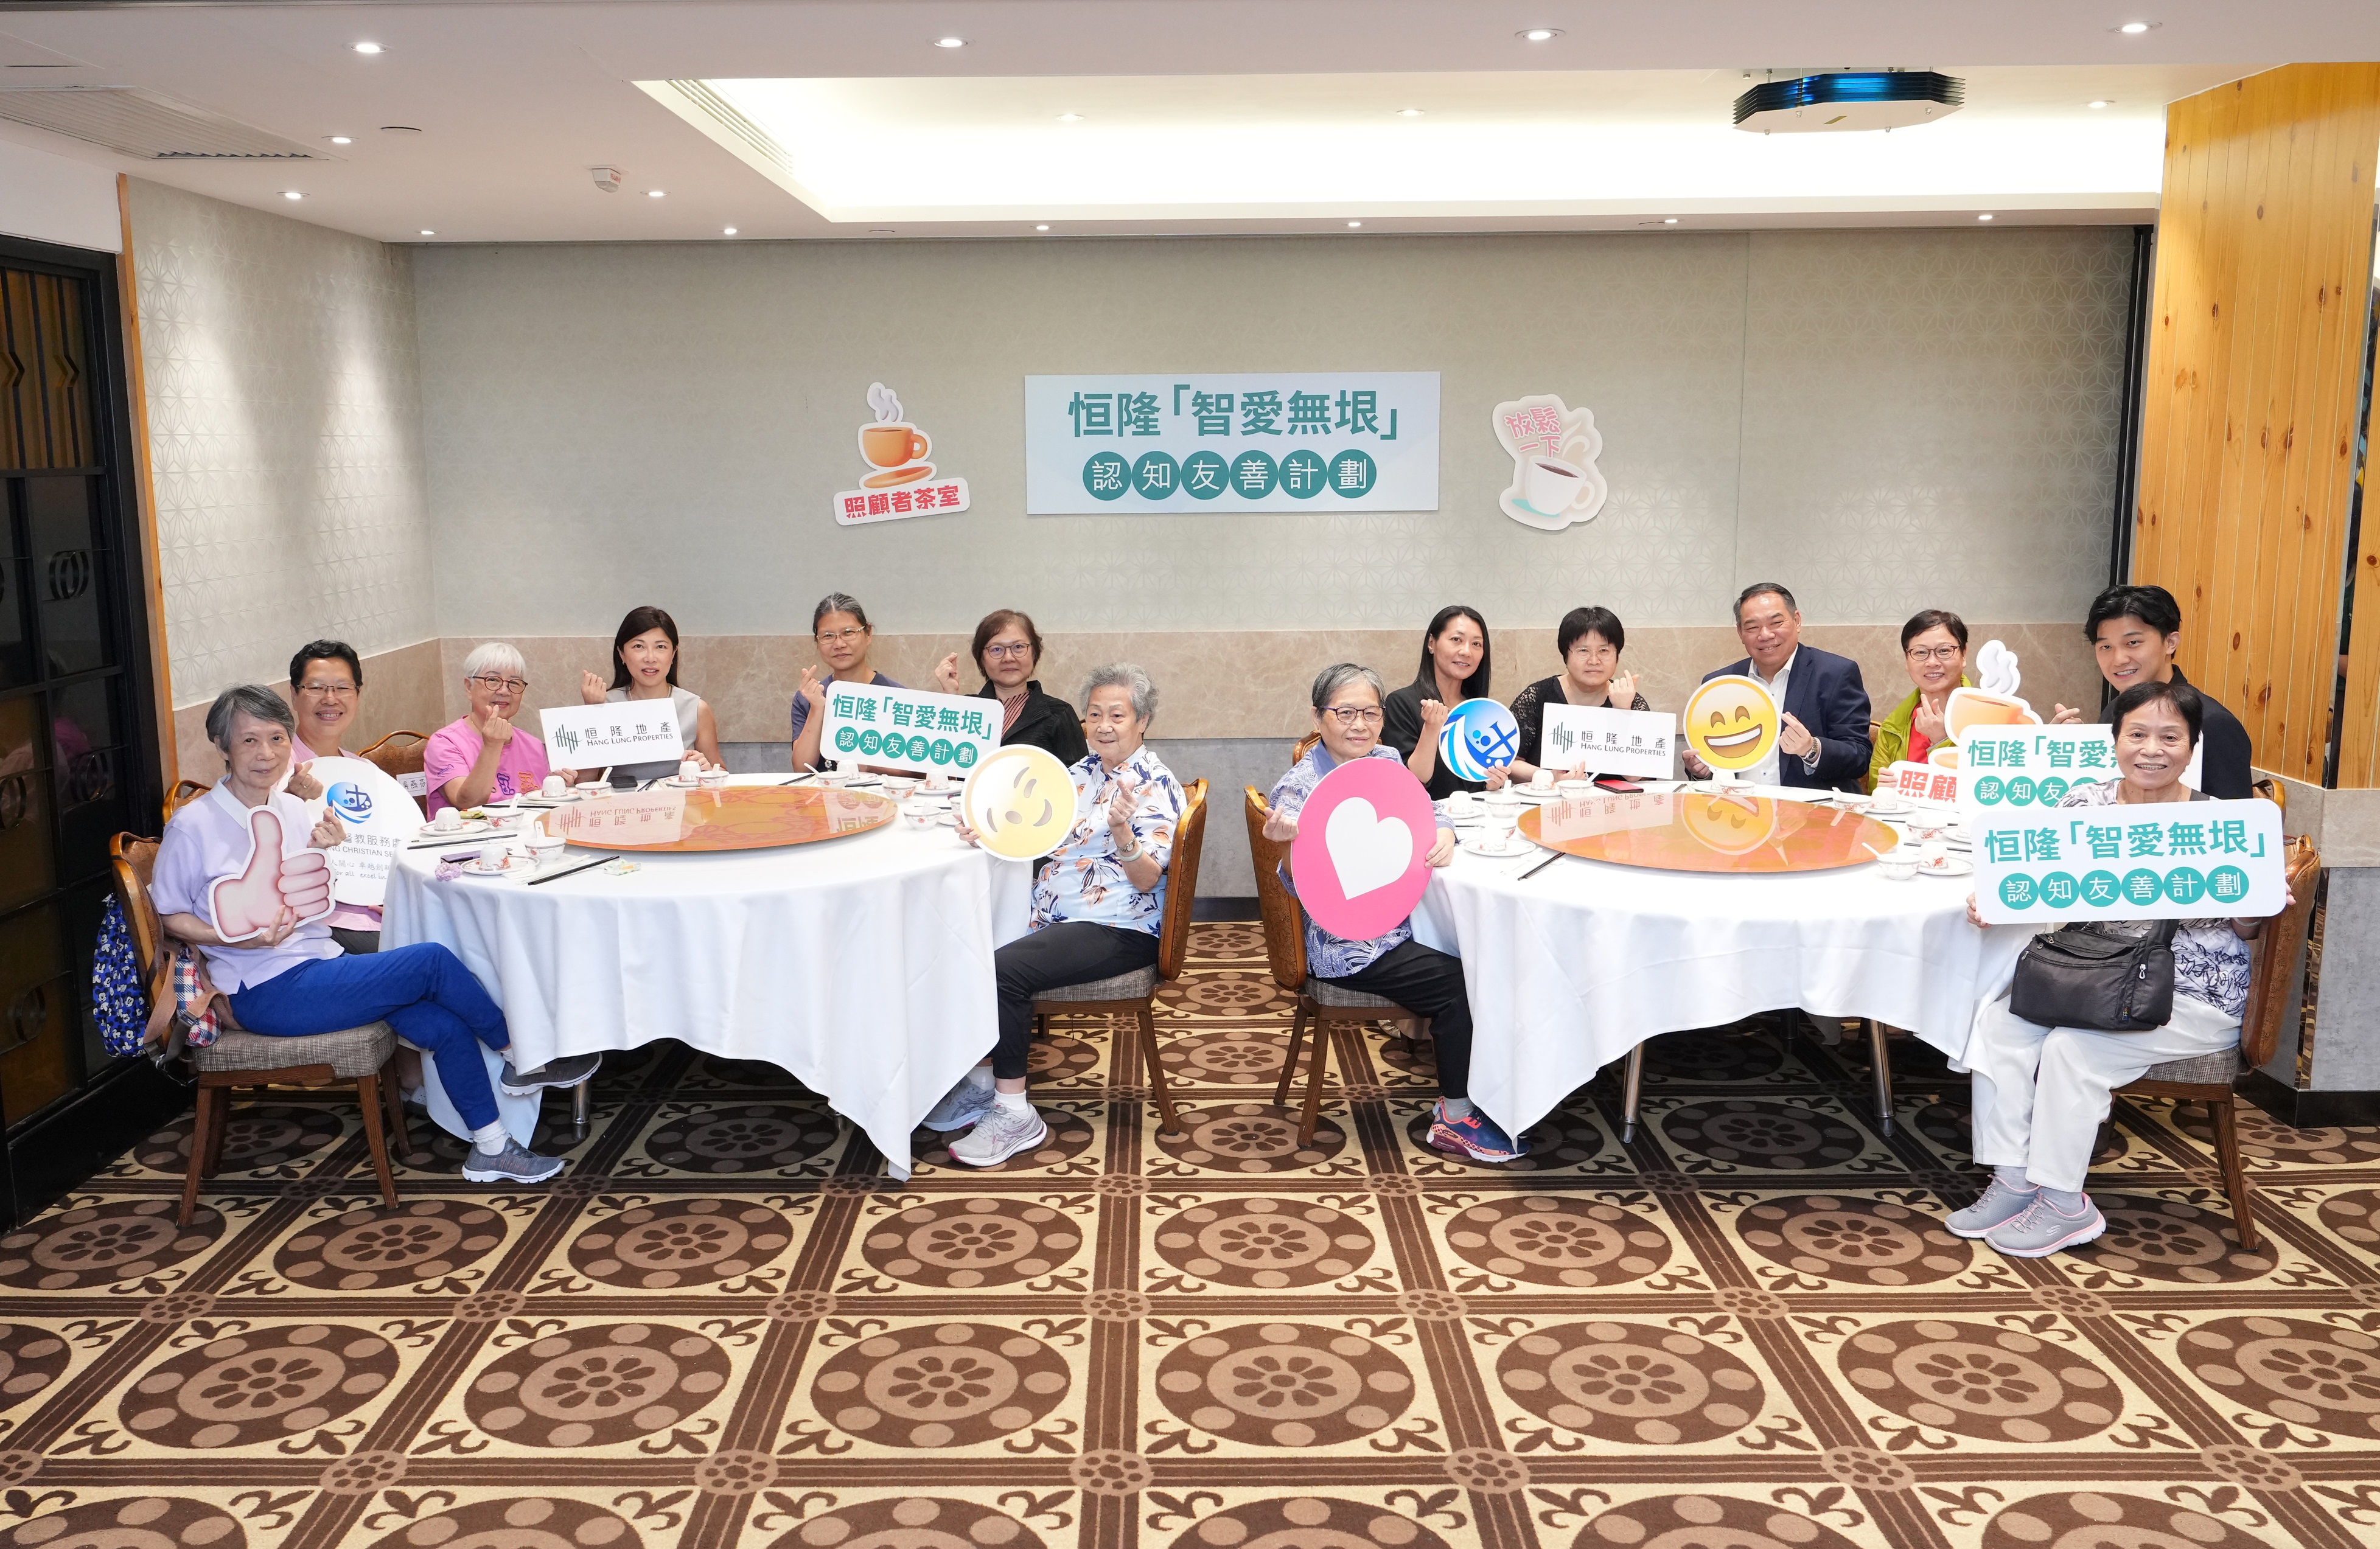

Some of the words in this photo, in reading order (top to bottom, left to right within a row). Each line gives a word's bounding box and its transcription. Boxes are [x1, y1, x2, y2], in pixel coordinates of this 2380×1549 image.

[1068, 384, 1397, 440] 恒隆「智愛無垠」
[1504, 406, 1562, 439] 放鬆
[1519, 436, 1561, 458] 一下
[1092, 459, 1367, 491] 認知友善計劃
[844, 485, 960, 518] 照顧者茶室
[832, 694, 992, 740] 恒隆「智愛無垠」
[633, 733, 674, 742] PROPERTIES
[839, 731, 974, 764] 認知友善計劃
[1581, 742, 1602, 751] HANG
[1625, 747, 1666, 756] PROPERTIES
[343, 846, 383, 857] CHRISTIAN
[1983, 820, 2266, 863] 恒隆「智愛無垠」
[2006, 871, 2241, 903] 認知友善計劃
